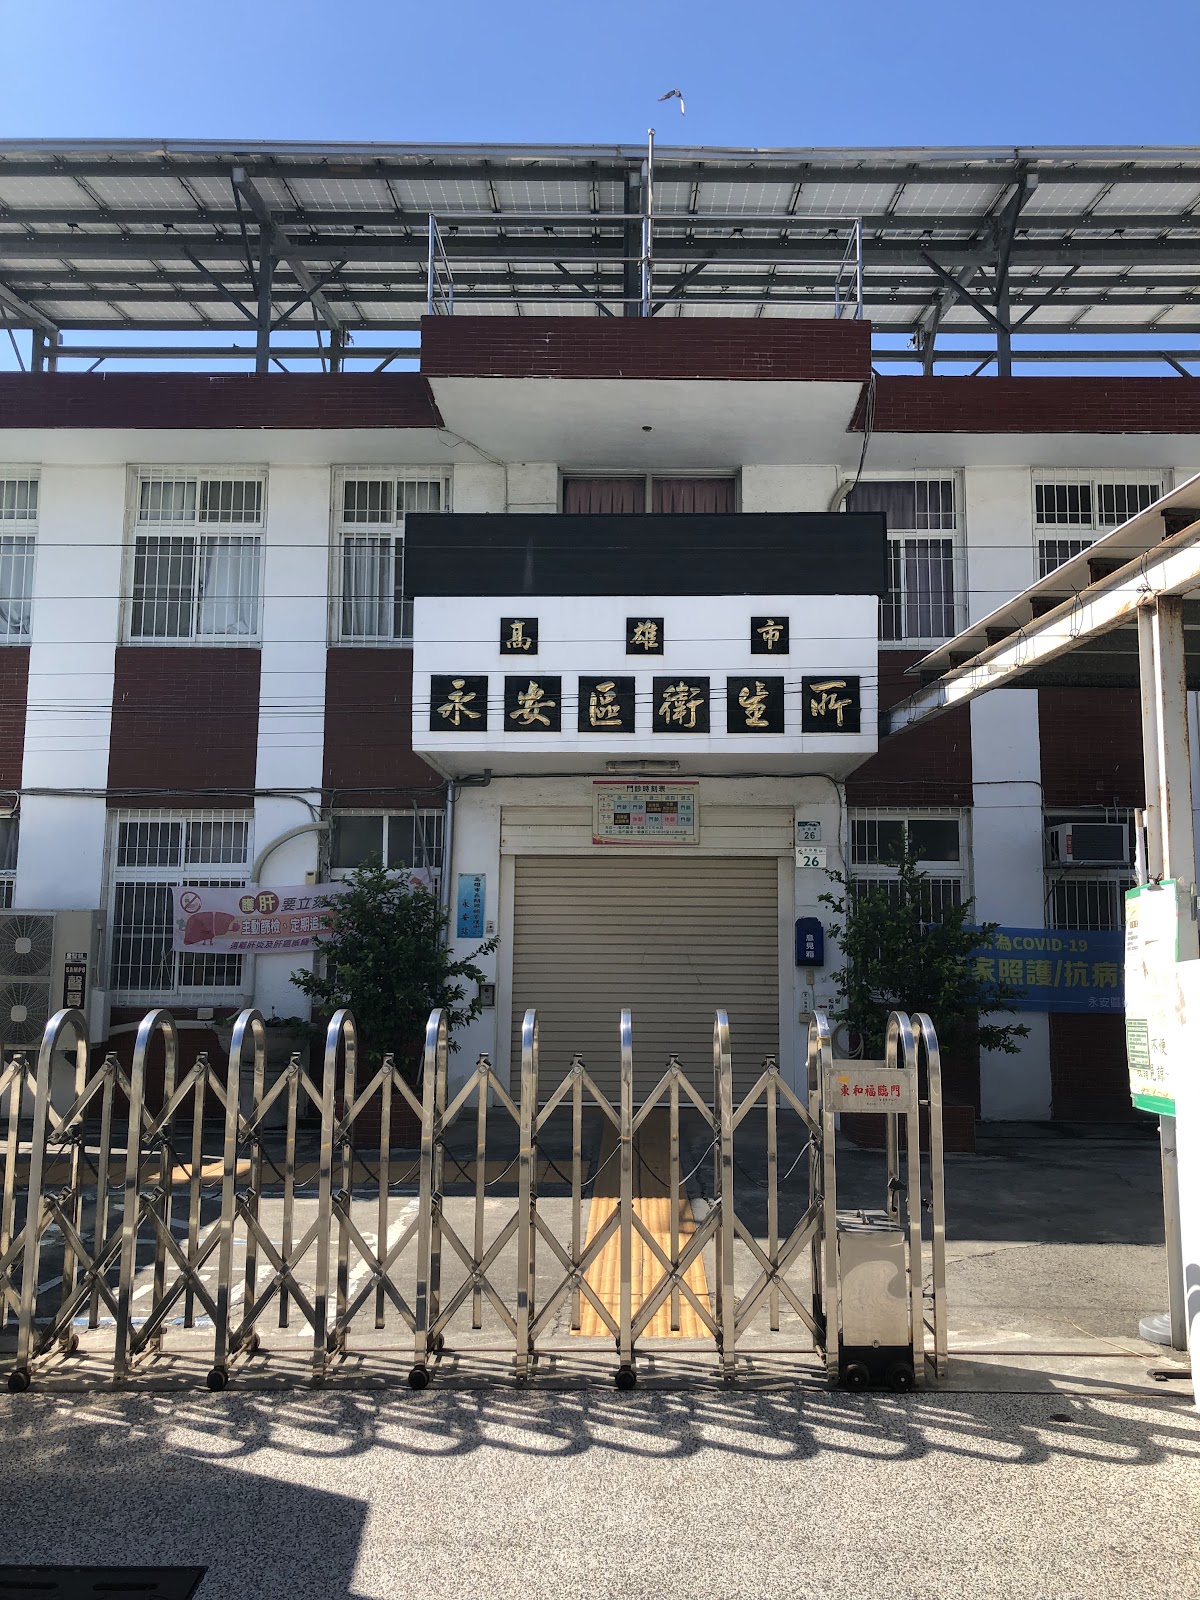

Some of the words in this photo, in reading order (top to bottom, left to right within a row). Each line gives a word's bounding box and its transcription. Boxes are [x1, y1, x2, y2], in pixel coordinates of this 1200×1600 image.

[505, 618, 785, 651] 高雄市
[440, 679, 853, 729] 永安區衛生所
[804, 831, 816, 840] 26
[803, 855, 820, 867] 26
[840, 1084, 901, 1097] 東和福臨門
